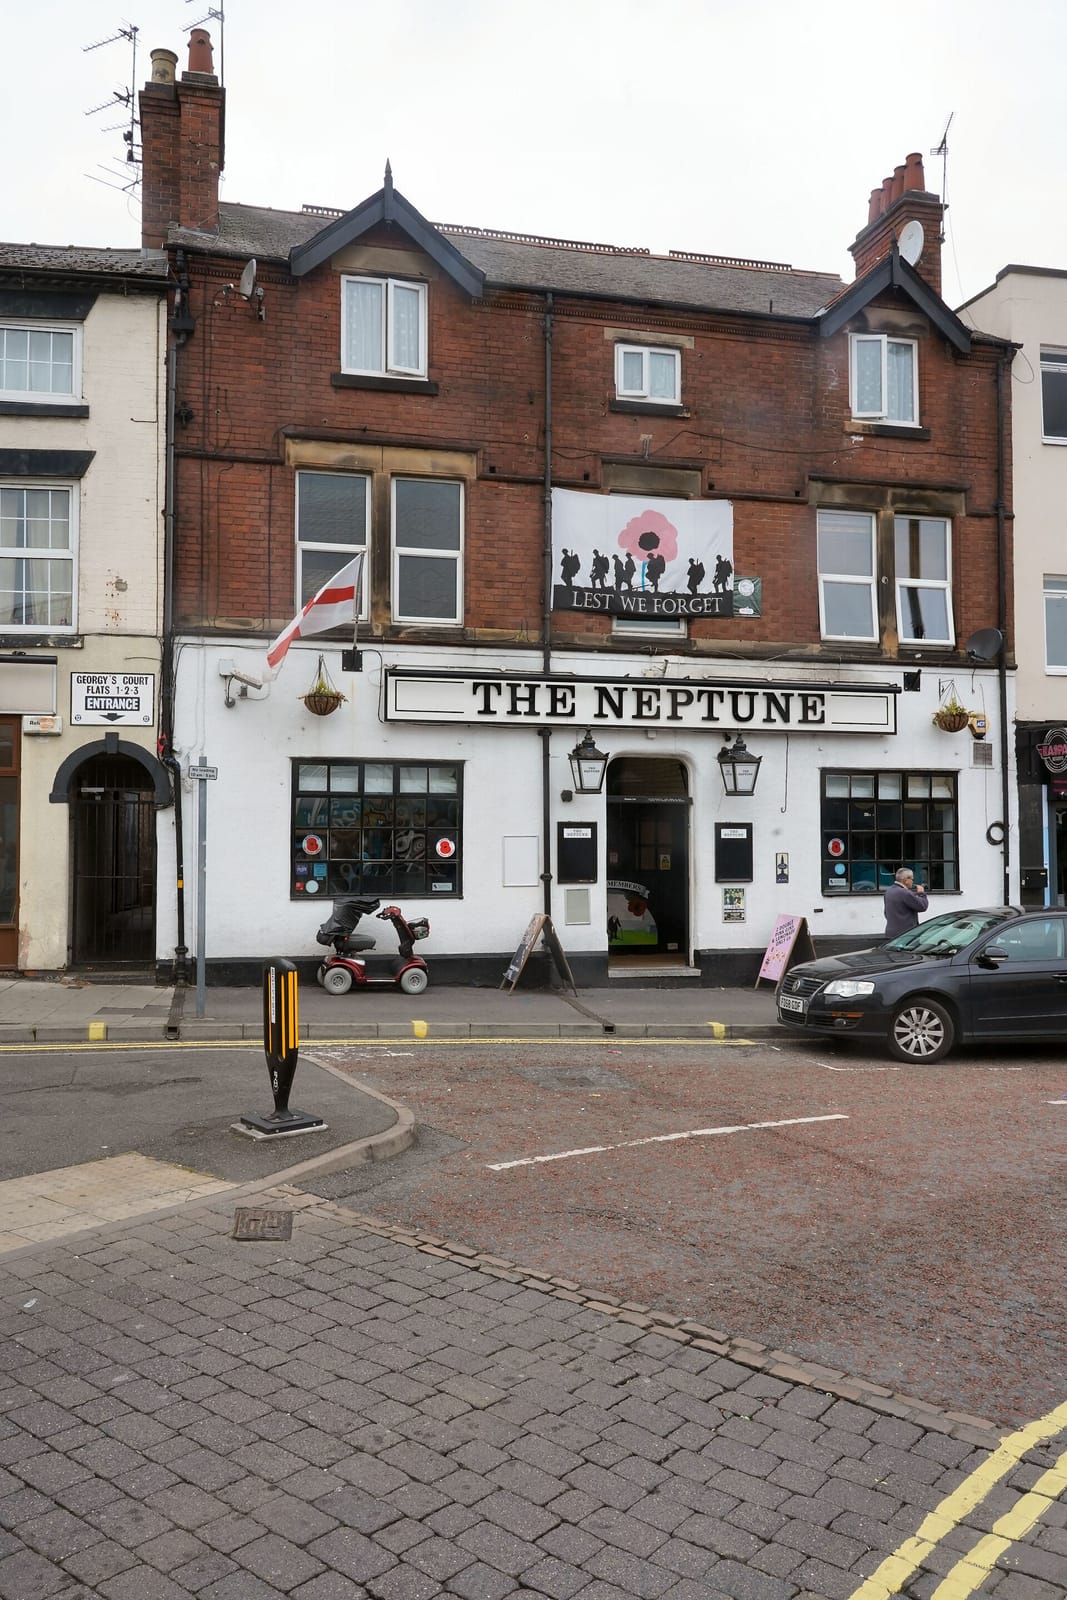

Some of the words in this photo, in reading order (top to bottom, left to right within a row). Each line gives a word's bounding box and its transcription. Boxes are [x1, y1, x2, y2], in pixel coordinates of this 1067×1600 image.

[572, 590, 614, 610] LEST
[619, 595, 648, 613] WE
[653, 597, 723, 615] FORGET
[122, 676, 149, 686] COURT
[86, 685, 110, 695] FLATS
[86, 697, 139, 710] ENTRANCE
[472, 681, 576, 718] THE
[593, 685, 827, 725] NEPTUNE
